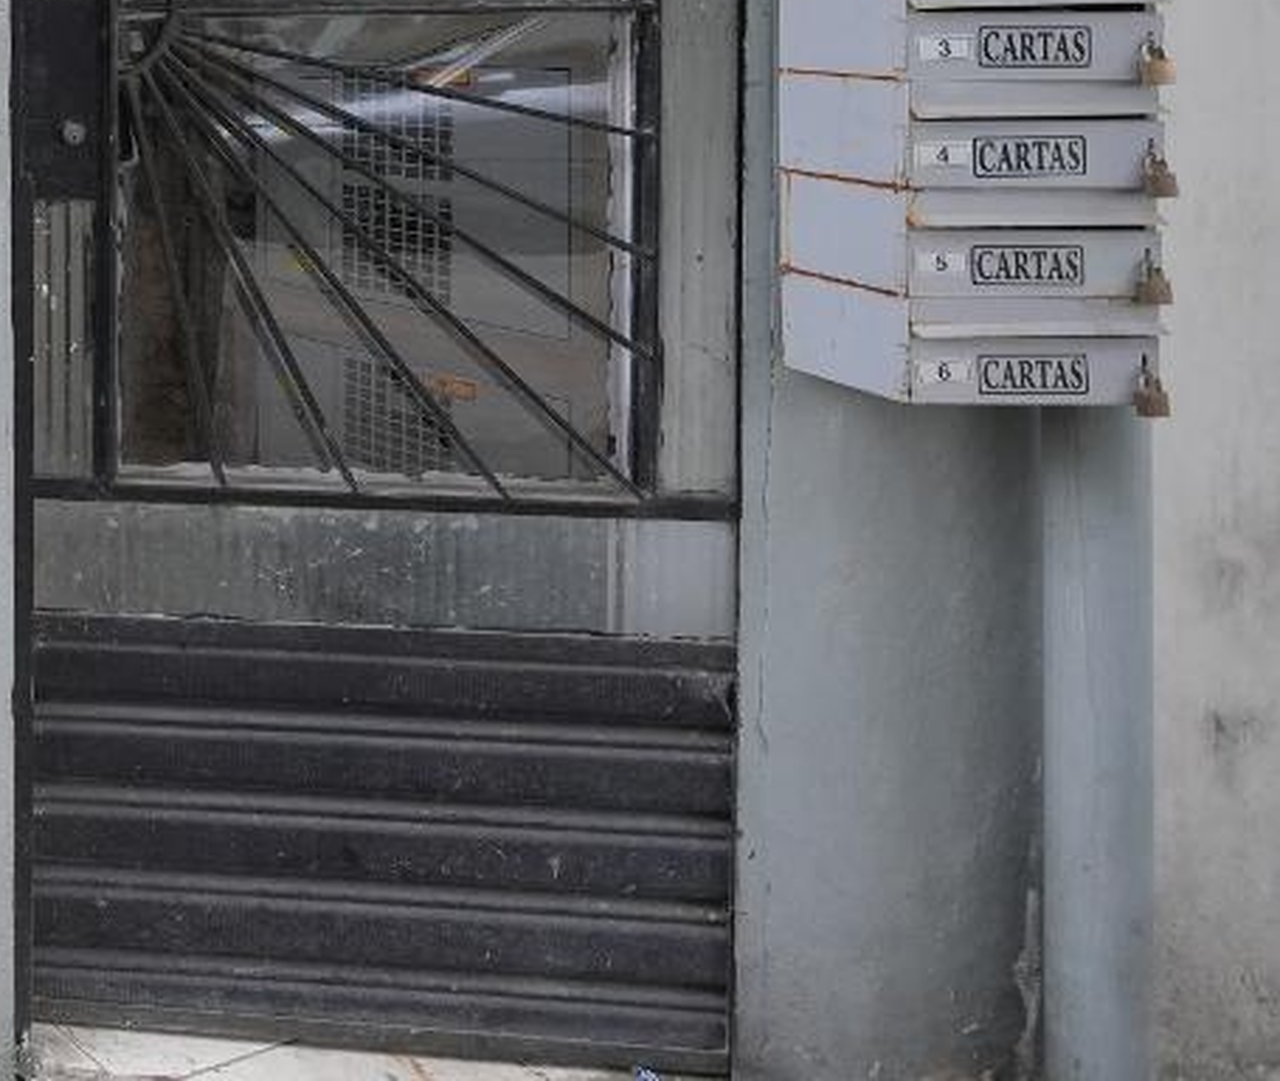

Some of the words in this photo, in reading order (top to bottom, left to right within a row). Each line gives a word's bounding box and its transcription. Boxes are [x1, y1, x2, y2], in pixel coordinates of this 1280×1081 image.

[938, 39, 952, 58] 3
[983, 31, 1087, 63] CARTAS
[935, 145, 950, 163] 4
[978, 139, 1081, 173] CARTAS
[935, 253, 948, 272] 5
[976, 249, 1080, 281] CARTAS
[938, 362, 952, 382] 6
[983, 357, 1085, 390] CARTAS
